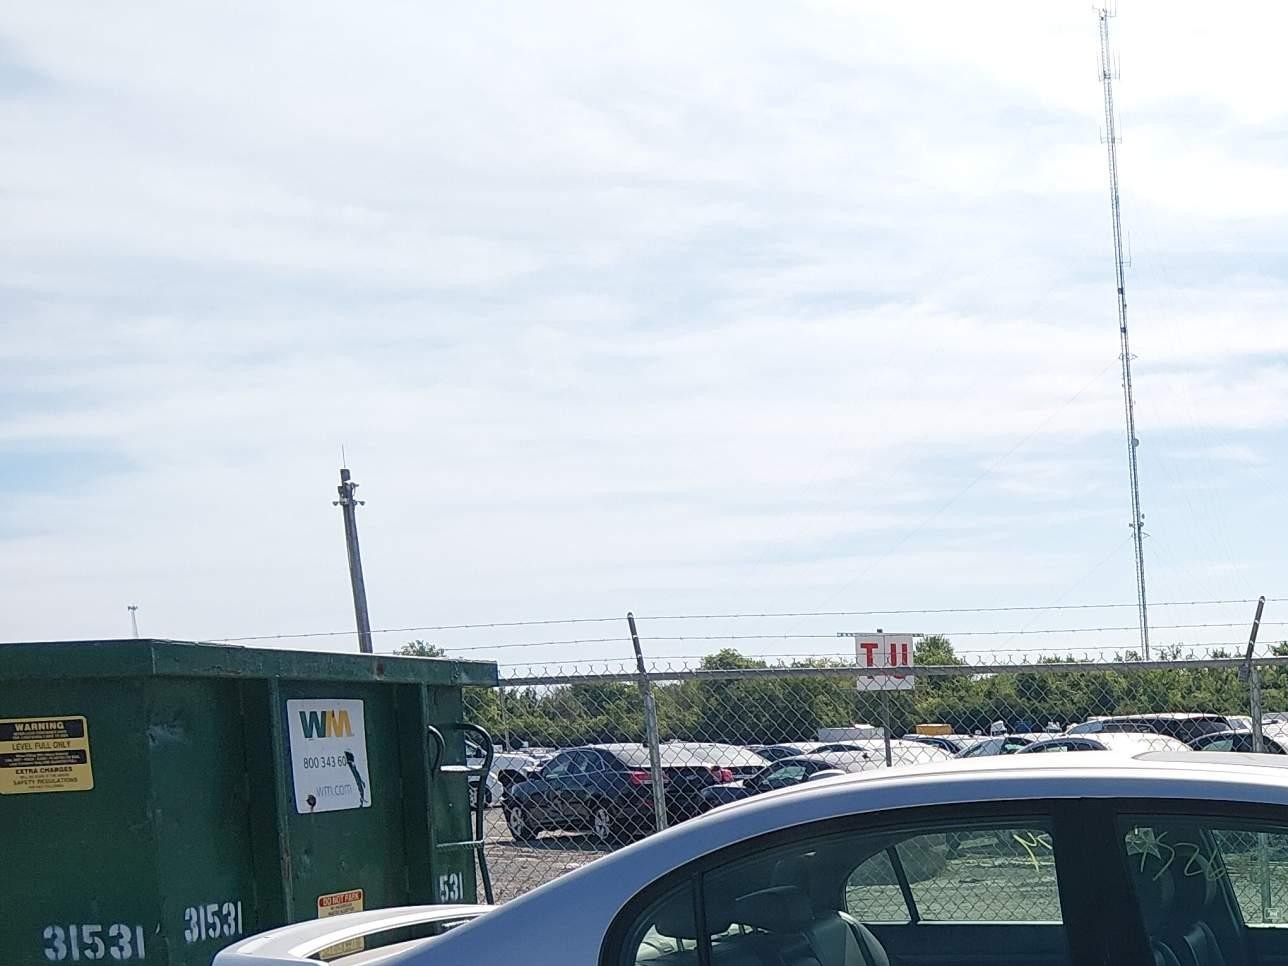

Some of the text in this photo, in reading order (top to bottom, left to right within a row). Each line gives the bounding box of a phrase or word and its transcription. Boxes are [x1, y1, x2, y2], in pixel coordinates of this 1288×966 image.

[15, 721, 65, 732] WARNING
[299, 710, 353, 738] WM
[12, 743, 33, 751] LEVEL
[303, 757, 319, 769] 800
[320, 756, 336, 768] 343
[316, 784, 353, 797] wm.com
[439, 872, 464, 903] 531
[184, 901, 243, 944] 31531
[43, 923, 146, 961] 31531
